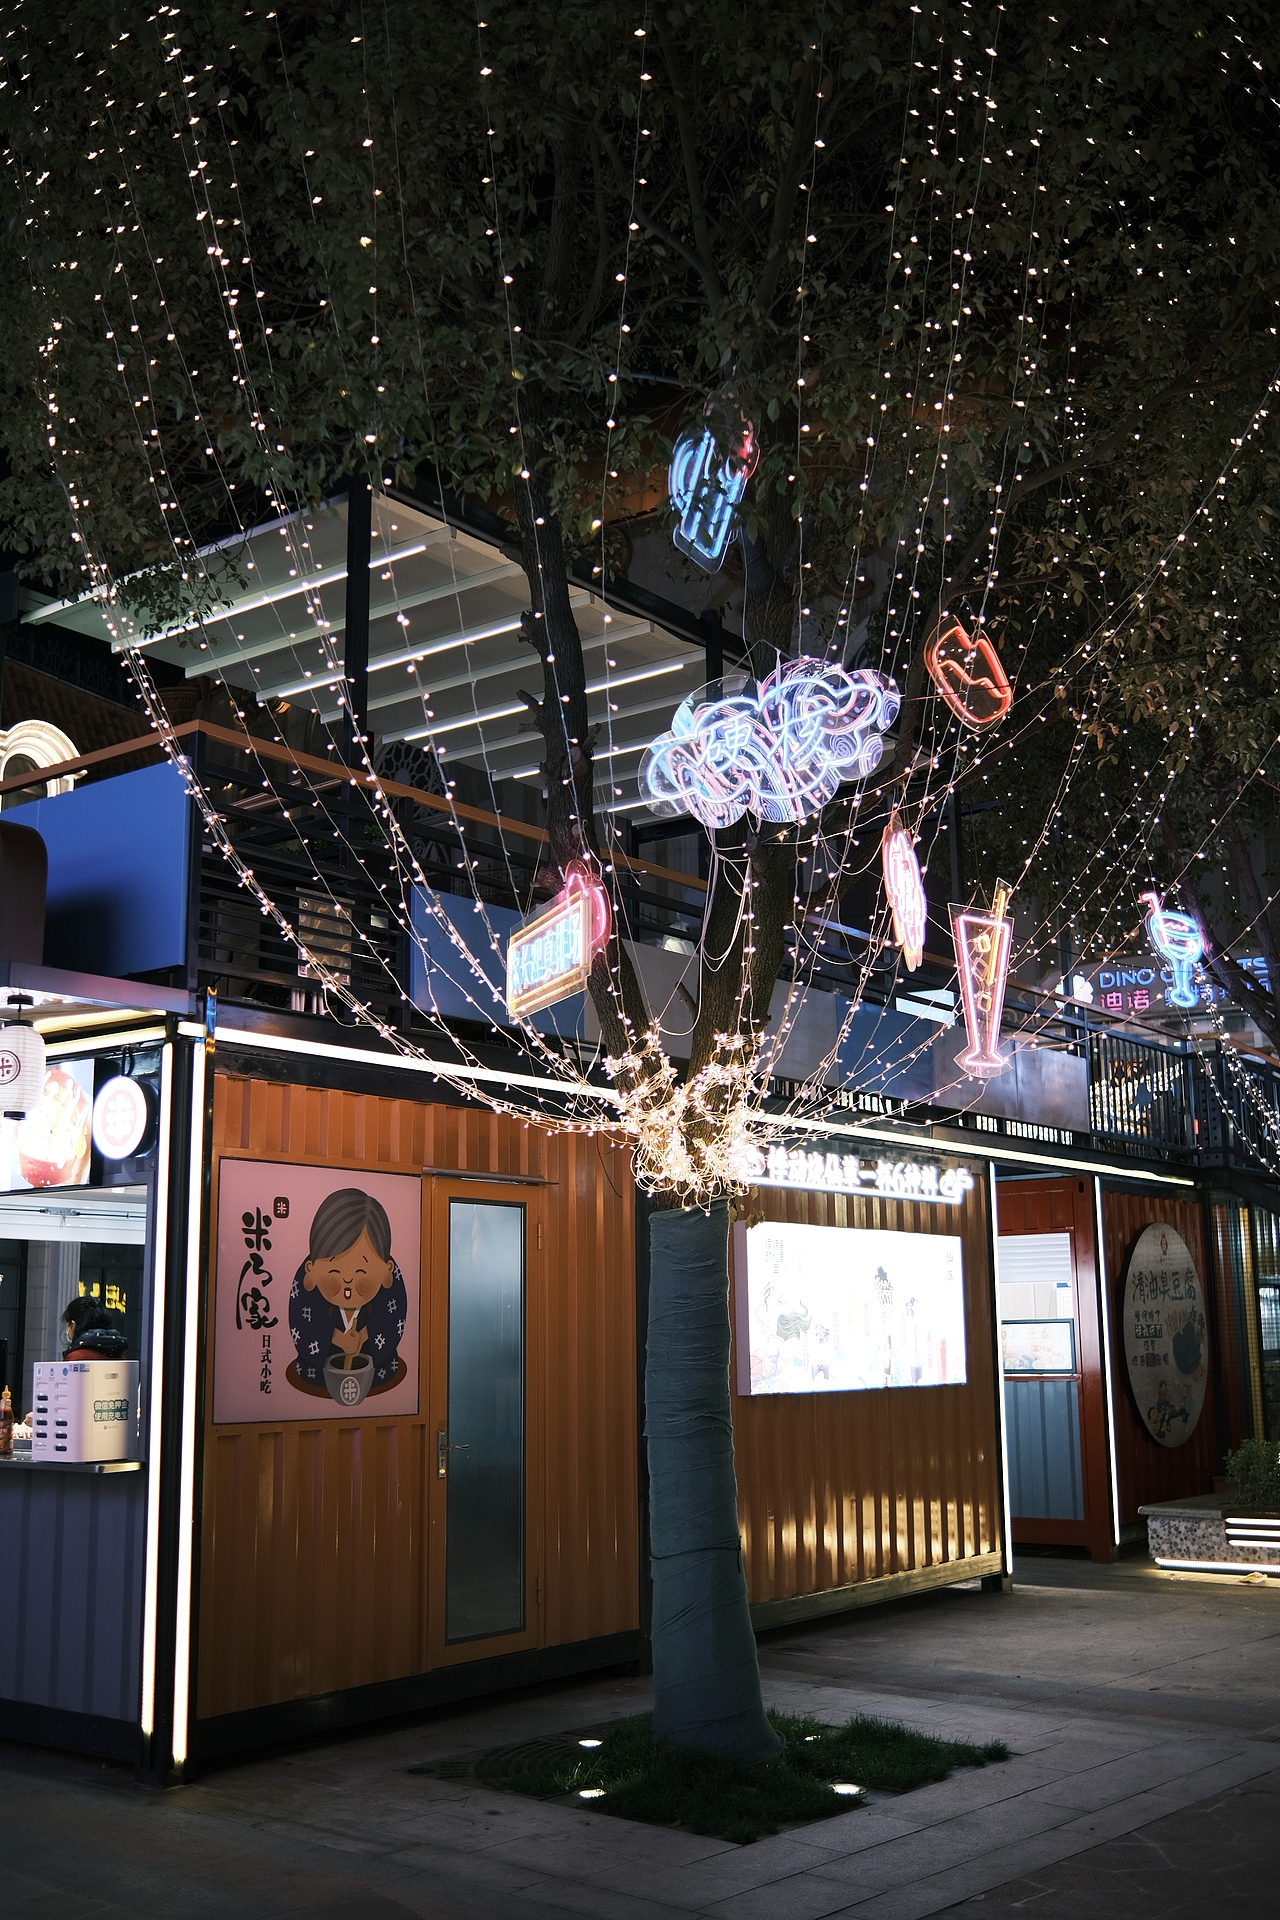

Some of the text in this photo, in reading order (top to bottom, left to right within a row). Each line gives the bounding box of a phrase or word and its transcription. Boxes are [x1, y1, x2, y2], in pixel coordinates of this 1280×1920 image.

[696, 699, 836, 773] 硬核
[1099, 968, 1156, 989] DINO
[1100, 989, 1150, 1011] 迪诺
[260, 1334, 272, 1394] 日式小吃
